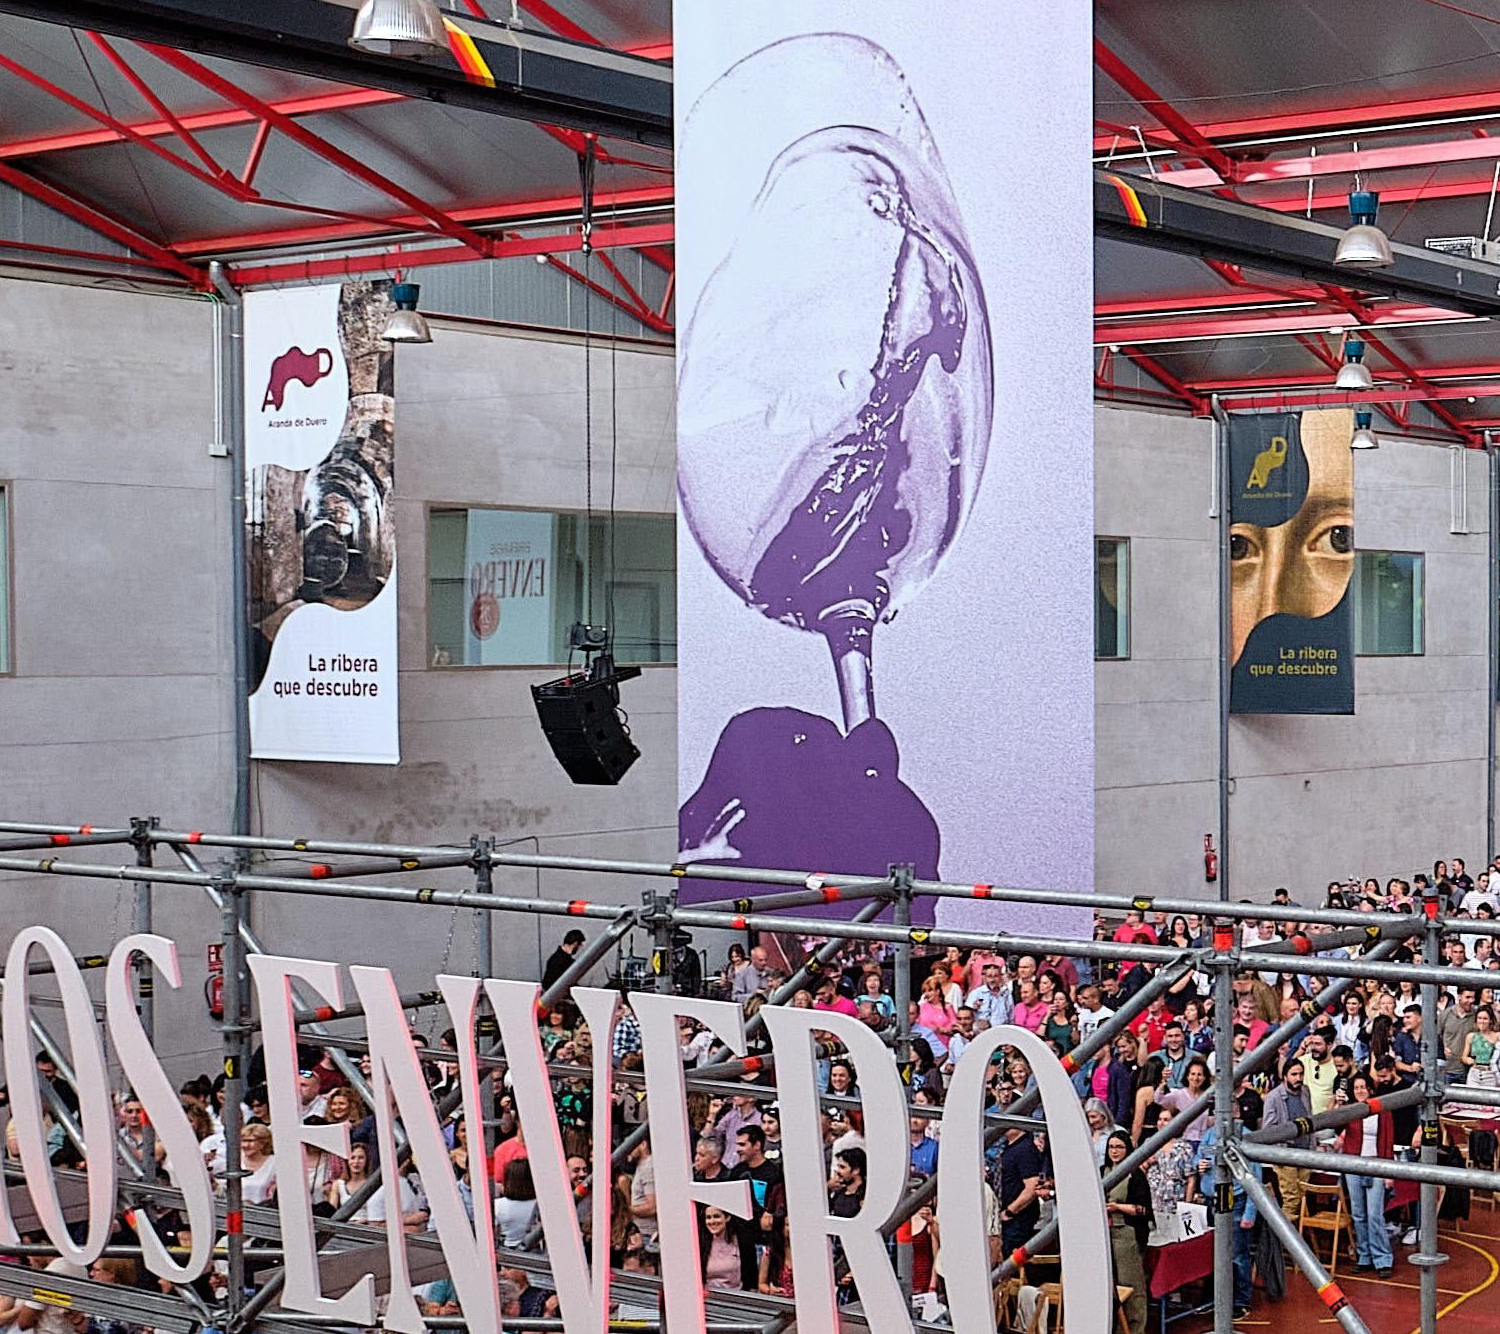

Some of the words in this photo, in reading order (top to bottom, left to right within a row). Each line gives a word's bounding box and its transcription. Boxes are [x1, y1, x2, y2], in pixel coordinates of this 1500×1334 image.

[1280, 648, 1296, 659] La
[1299, 647, 1338, 660] ribera
[309, 654, 326, 672] La
[331, 654, 378, 672] ribera
[1249, 664, 1274, 677] que
[1277, 663, 1338, 675] descubre
[273, 681, 301, 698] que
[306, 677, 378, 697] descubre
[1184, 1221, 1195, 1236] K
